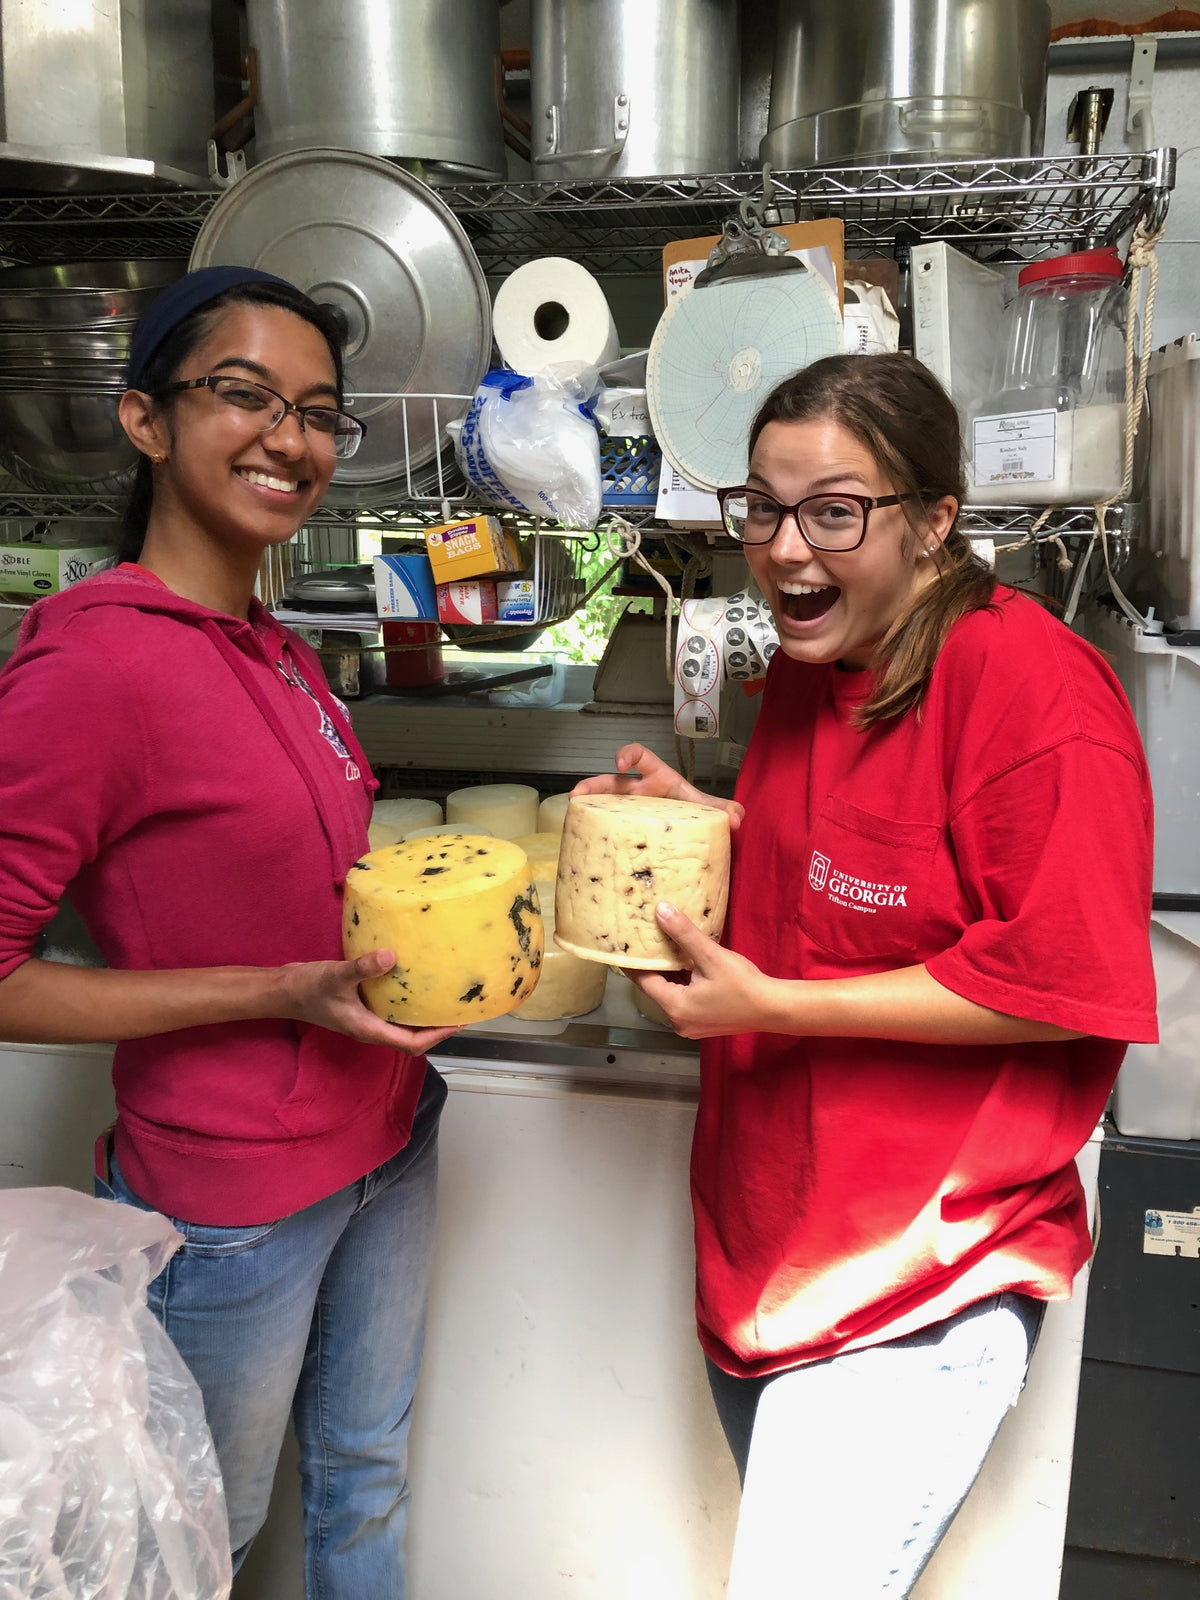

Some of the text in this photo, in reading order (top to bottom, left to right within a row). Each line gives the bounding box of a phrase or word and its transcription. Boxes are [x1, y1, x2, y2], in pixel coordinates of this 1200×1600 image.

[445, 532, 479, 552] SNACK
[446, 542, 482, 559] BAGS
[17, 569, 31, 578] Vinyl
[32, 570, 51, 578] Gloves
[833, 869, 891, 892] UNIVERSITY
[893, 885, 908, 893] OF
[828, 878, 908, 907] GEORGIA
[827, 893, 877, 914] Tifton Campus
